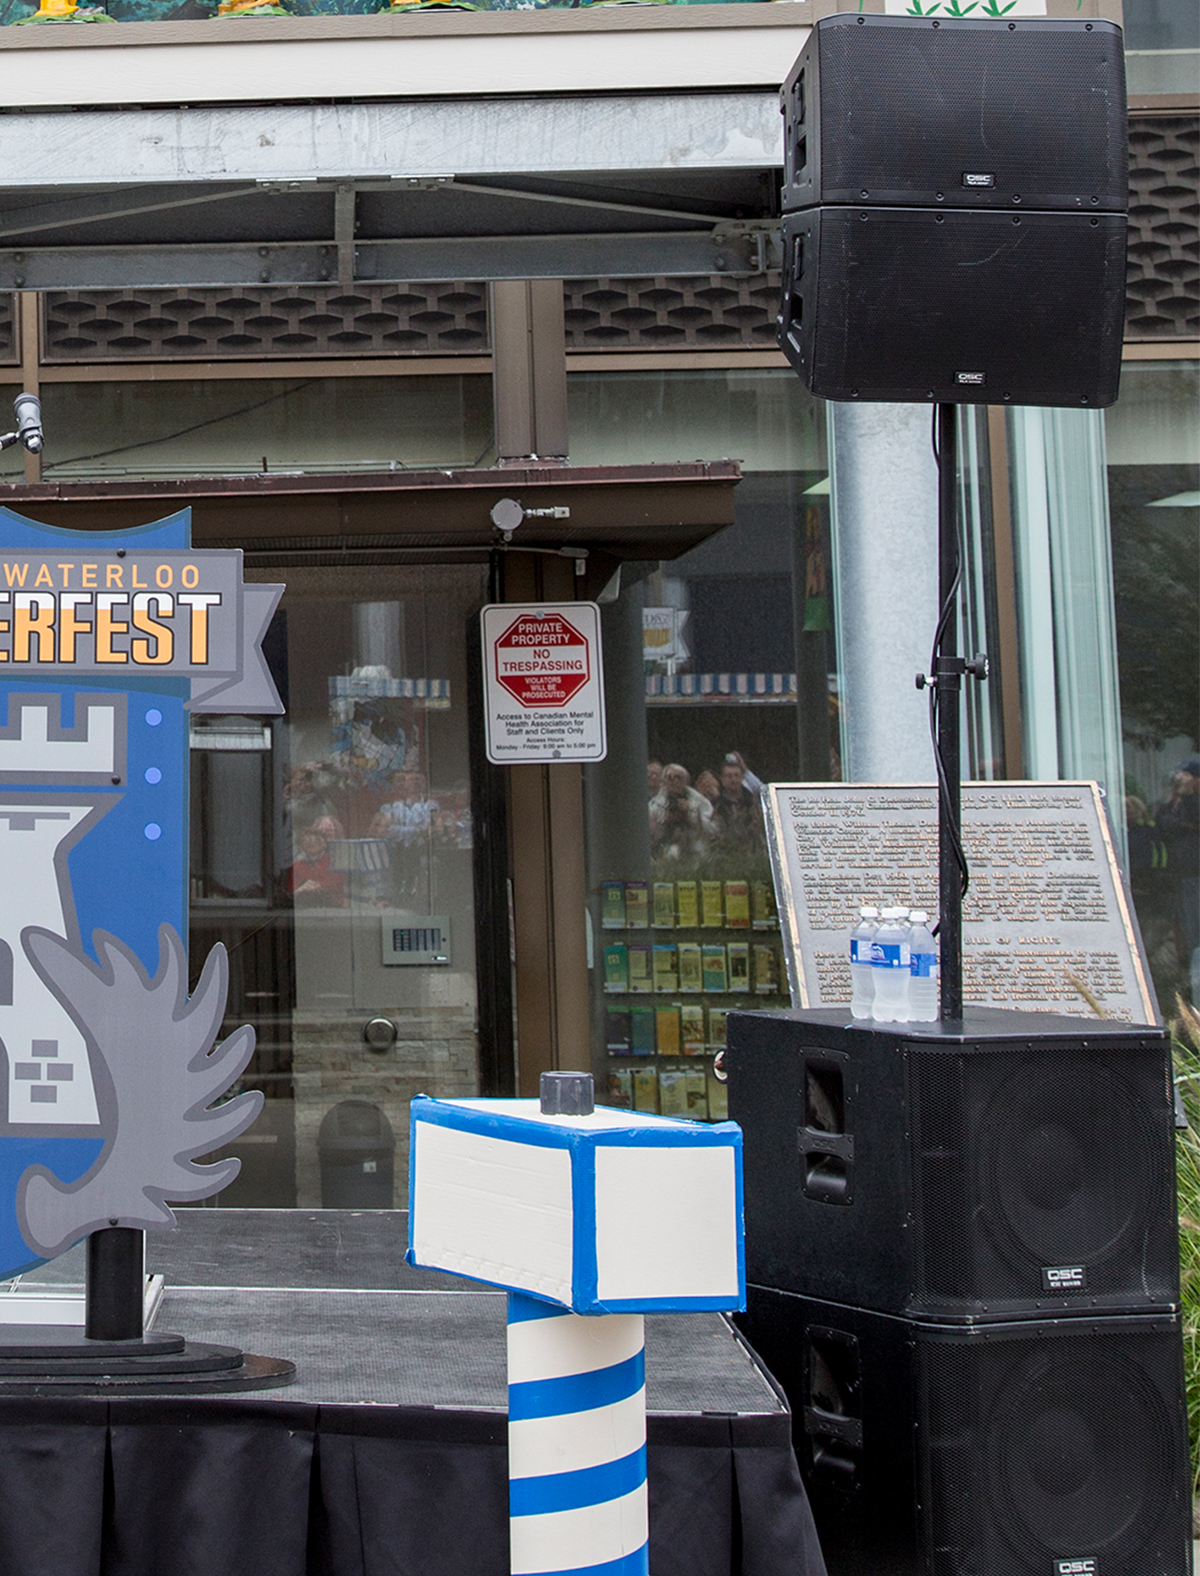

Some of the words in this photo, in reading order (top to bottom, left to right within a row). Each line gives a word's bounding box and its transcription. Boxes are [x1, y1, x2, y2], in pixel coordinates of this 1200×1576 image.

[518, 623, 563, 633] PRIVATE
[511, 634, 571, 645] PROPERTY
[533, 649, 550, 659] NO
[502, 660, 582, 672] TRESPASSING
[525, 676, 562, 684] VIOLATORS
[522, 691, 566, 699] PROSECUTED
[533, 712, 568, 720] Canadian
[570, 711, 594, 719] Mental
[506, 728, 523, 736] Staff
[540, 727, 565, 735] Clients
[567, 727, 584, 736] Only
[964, 937, 990, 945] BILL
[996, 937, 1011, 945] OF
[1019, 937, 1061, 945] RIGHTS
[1048, 1268, 1083, 1280] QSC
[1059, 1560, 1095, 1573] QSC
